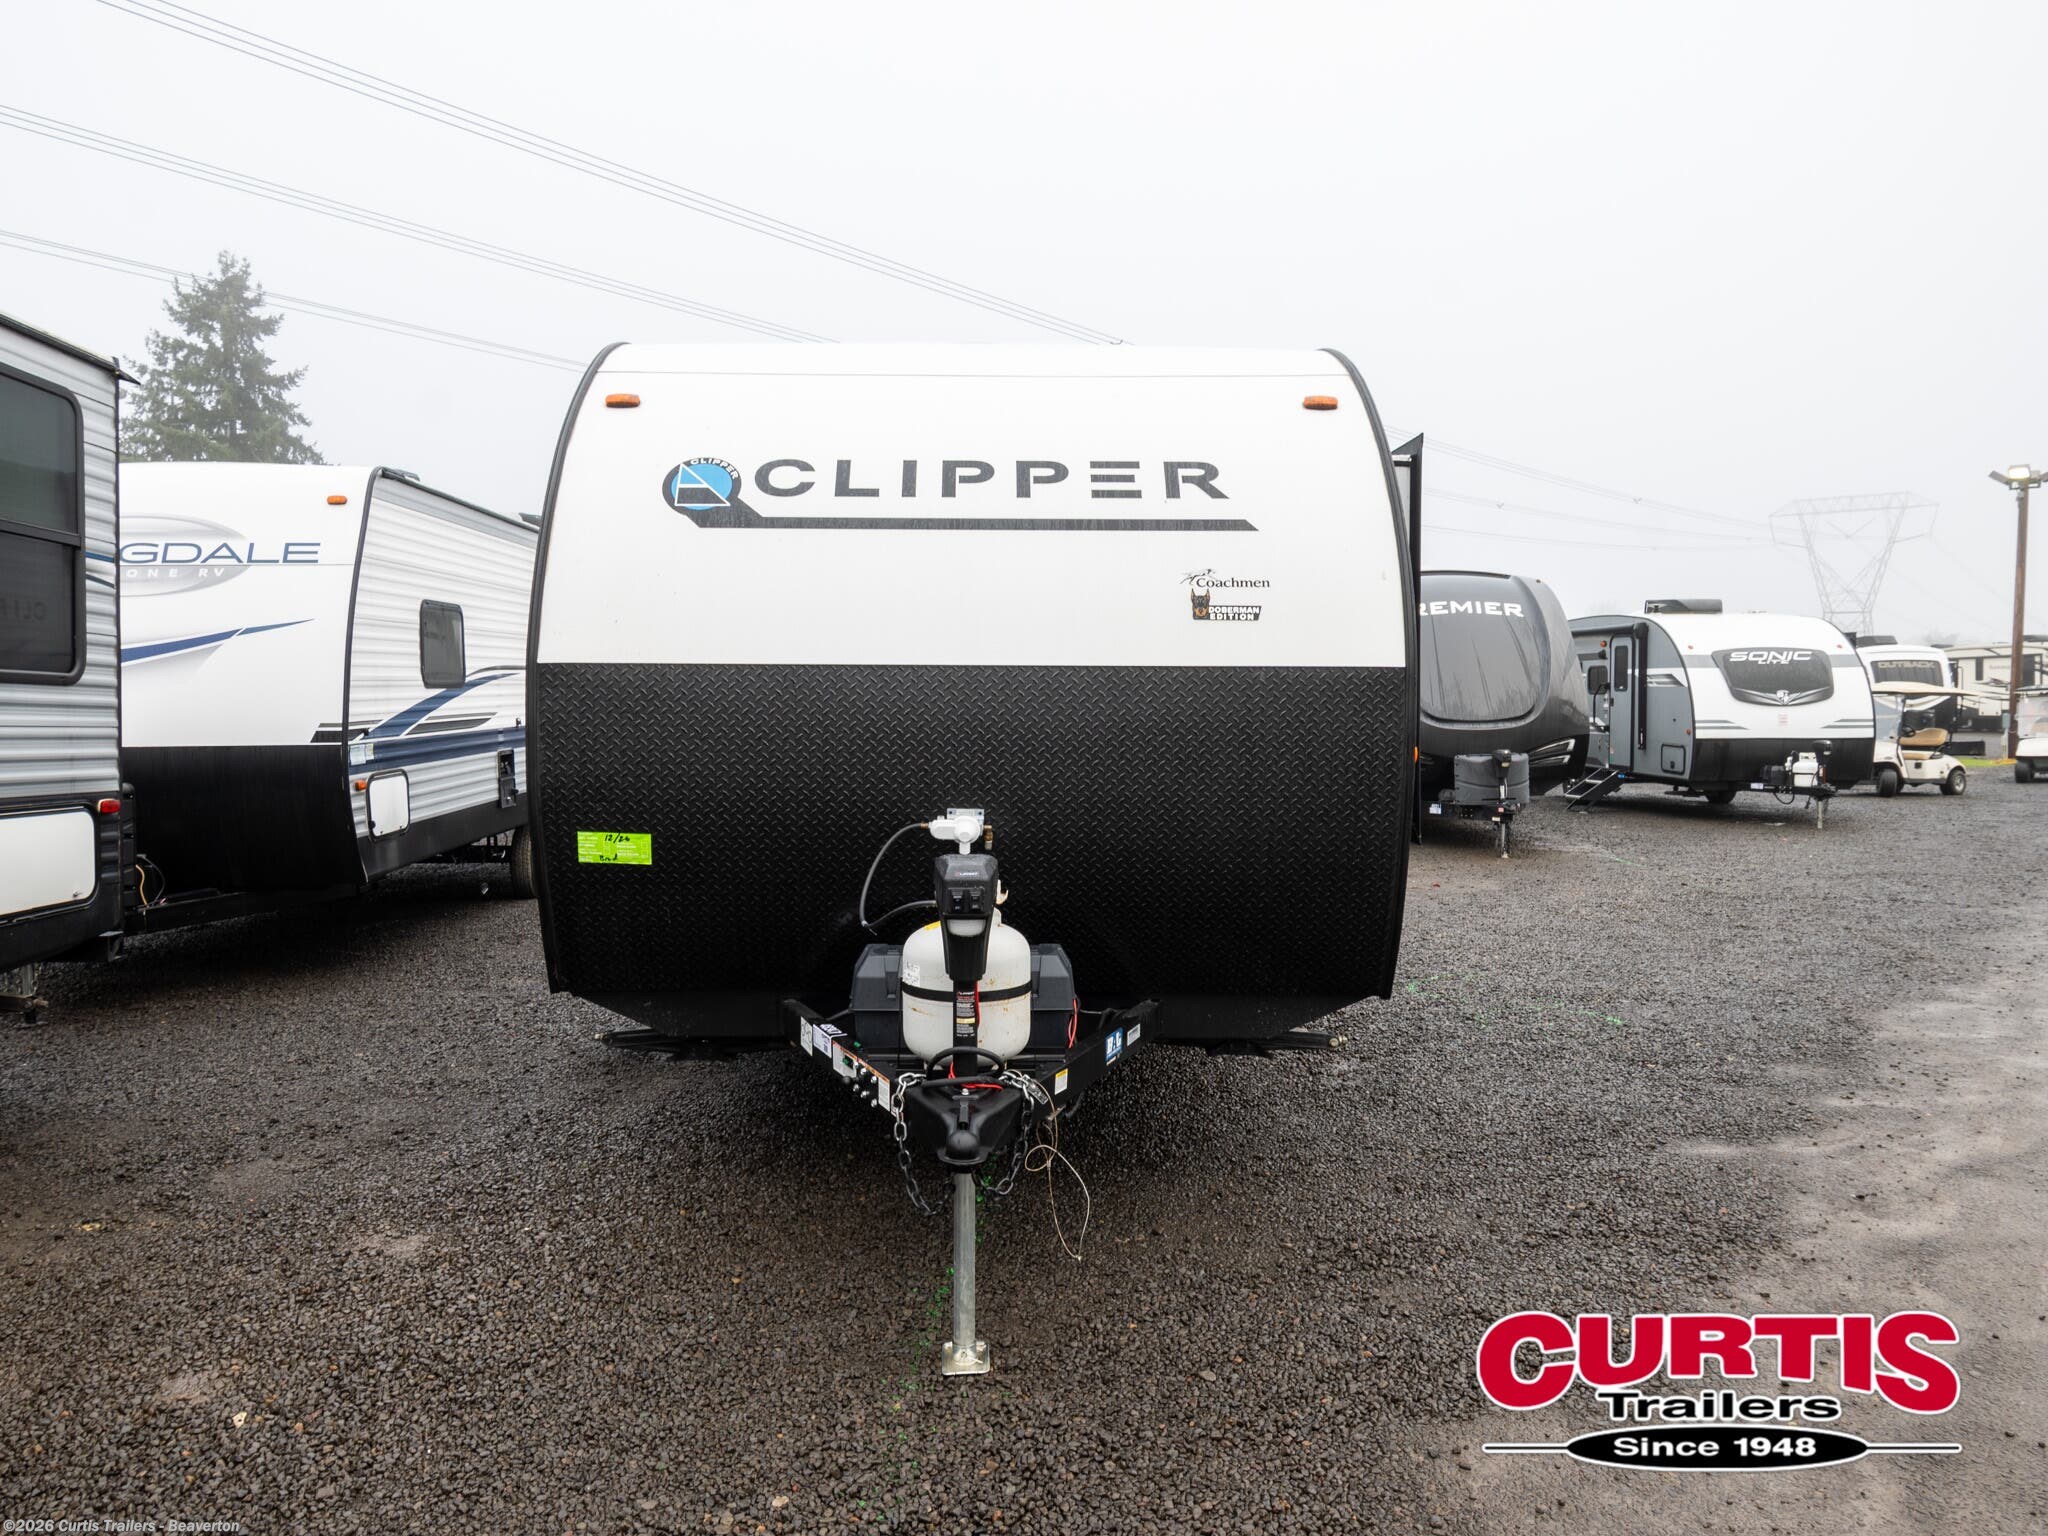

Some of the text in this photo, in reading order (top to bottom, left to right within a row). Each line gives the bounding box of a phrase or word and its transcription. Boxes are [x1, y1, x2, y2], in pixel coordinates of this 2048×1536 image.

[690, 457, 739, 480] CLIPPER
[754, 459, 1230, 499] CLIPPER
[198, 567, 225, 577] RV
[1196, 577, 1270, 588] Coachmen
[1208, 606, 1260, 614] DOBERMAN
[1209, 613, 1255, 621] EDITION
[1729, 651, 1813, 662] SONIC
